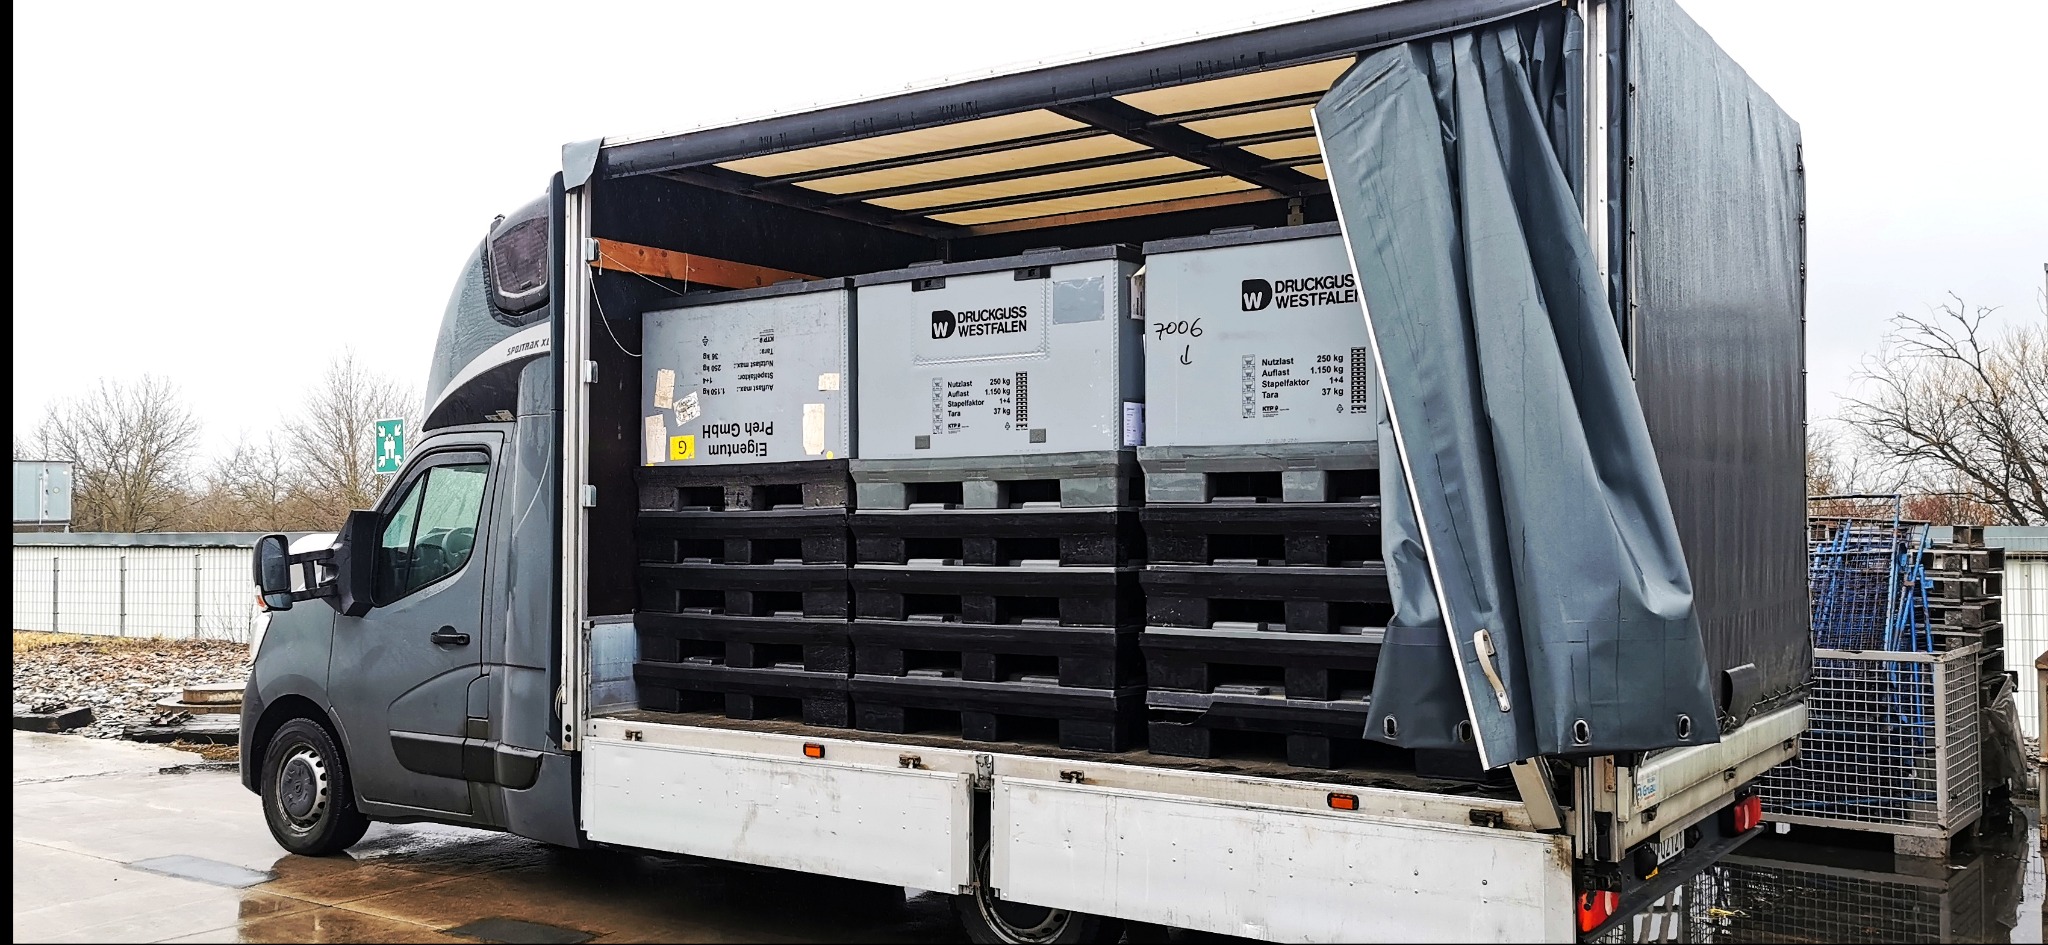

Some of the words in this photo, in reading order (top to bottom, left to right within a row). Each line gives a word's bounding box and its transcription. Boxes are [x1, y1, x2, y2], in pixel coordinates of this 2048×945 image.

[1275, 274, 1354, 294] DRUCKGUS
[958, 306, 1027, 324] DRUCKGUSS
[958, 320, 1027, 338] WESTFALEN
[1153, 317, 1203, 340] 7006
[702, 352, 710, 360] kg
[1262, 358, 1294, 366] Nutzlast
[1316, 354, 1331, 362] 250
[1334, 354, 1344, 363] kg
[702, 364, 710, 372] kg
[711, 364, 721, 372] 250
[750, 360, 774, 368] Nutzlast
[1262, 368, 1290, 377] Auflast
[1310, 366, 1331, 374] 1.150
[1334, 365, 1344, 374] kg
[753, 384, 774, 392] Auflast
[947, 380, 973, 388] Nutzlast
[1002, 378, 1010, 386] kg
[1262, 379, 1310, 389] Stapelfaktor
[1329, 376, 1344, 384] 1+4
[702, 388, 710, 396] kg
[948, 390, 969, 398] Auflast
[985, 388, 1001, 396] 1.150
[1002, 388, 1010, 396] kg
[1262, 391, 1279, 399] Tara
[1322, 388, 1331, 396] 37
[1334, 387, 1344, 396] kg
[947, 400, 985, 408] Stapelfaktor
[1002, 407, 1010, 415] kg
[702, 423, 740, 439] GmbH
[745, 421, 774, 436] Preh
[678, 440, 687, 454] G
[708, 440, 767, 457] Eigentum
